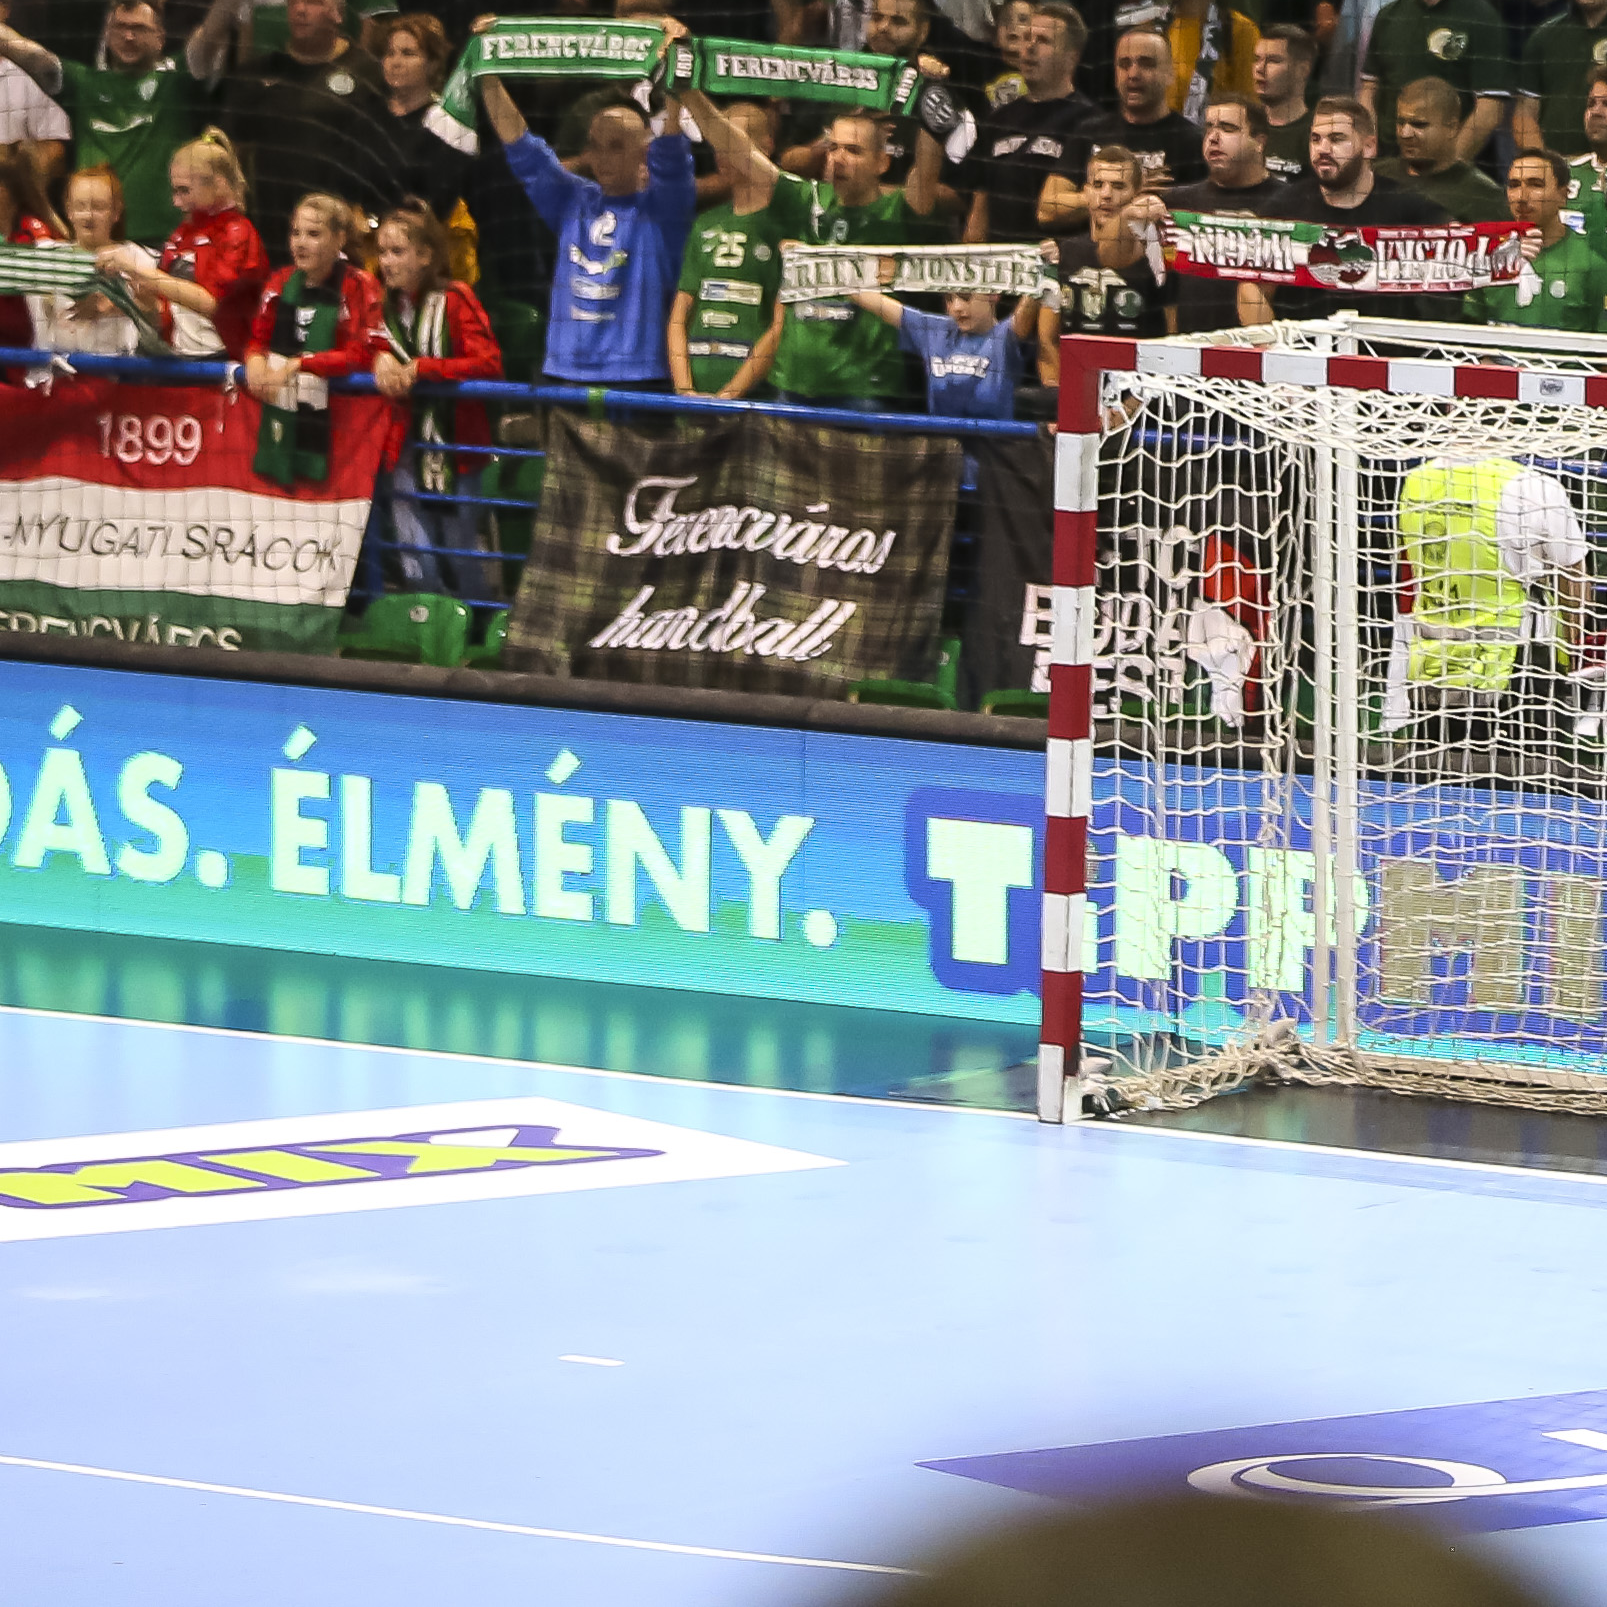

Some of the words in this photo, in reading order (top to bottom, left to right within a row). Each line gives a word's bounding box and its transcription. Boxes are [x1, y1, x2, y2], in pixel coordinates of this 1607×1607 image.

[99, 414, 202, 465] 1899
[588, 578, 858, 663] handball
[270, 724, 839, 949] ÉLMÉNY.
